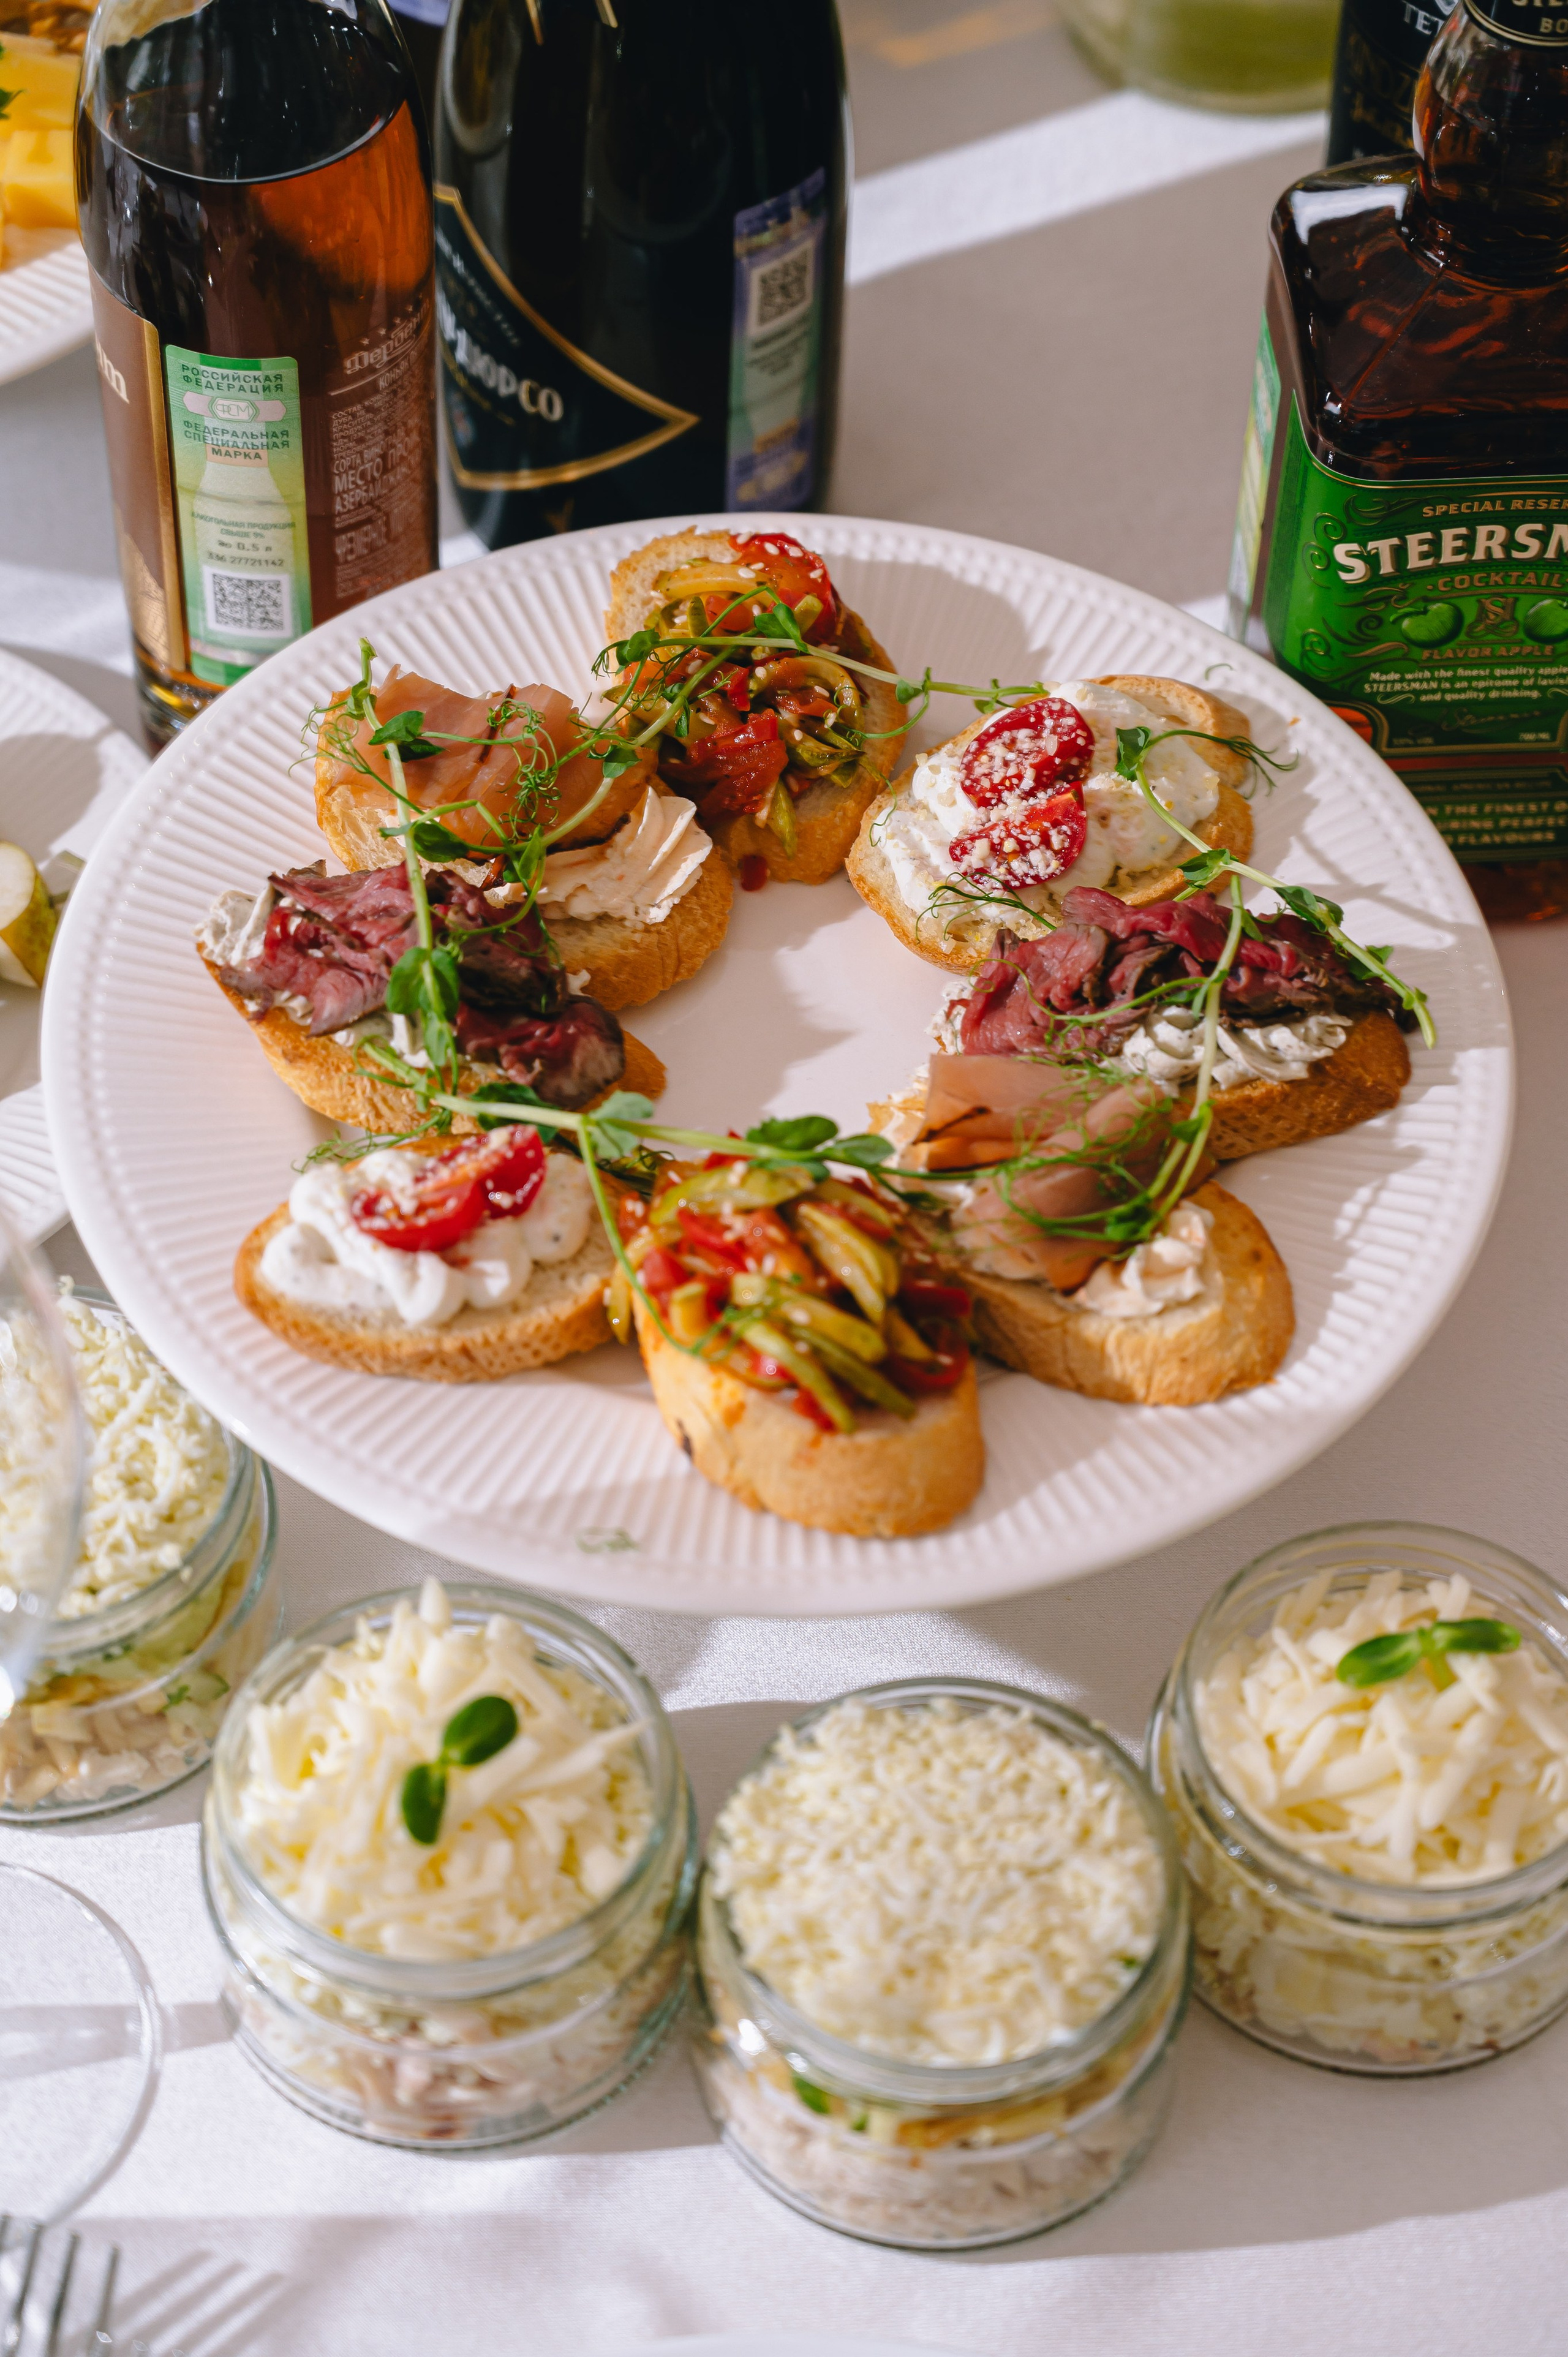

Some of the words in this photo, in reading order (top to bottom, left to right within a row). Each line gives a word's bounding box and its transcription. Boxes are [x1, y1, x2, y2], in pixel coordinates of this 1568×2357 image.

[182, 364, 284, 384] РОССИЙСКАЯ
[183, 374, 284, 394] ФЕДЕРАЦИЯ
[184, 420, 290, 440] ФЕДЕРАЛЬНАЯ
[184, 430, 290, 450] СПЕЦИАЛЬНАЯ
[211, 448, 263, 460] МАРКА
[334, 458, 383, 494] МЕСТО
[1422, 499, 1505, 518] SPECIAL
[1438, 571, 1562, 592] COCKTAIL
[1422, 647, 1492, 660] FLAVOR
[1496, 645, 1554, 657] APPLE
[1370, 671, 1401, 682] Made
[1404, 669, 1431, 680] with
[1434, 668, 1453, 678] the
[1457, 667, 1490, 677] finest
[1493, 665, 1536, 677] quality
[1364, 681, 1438, 693] STEERSMAN
[1441, 679, 1451, 689] is
[1471, 678, 1520, 689] epitome
[1522, 676, 1535, 686] of
[1419, 691, 1442, 702] and
[1444, 690, 1486, 702] quality
